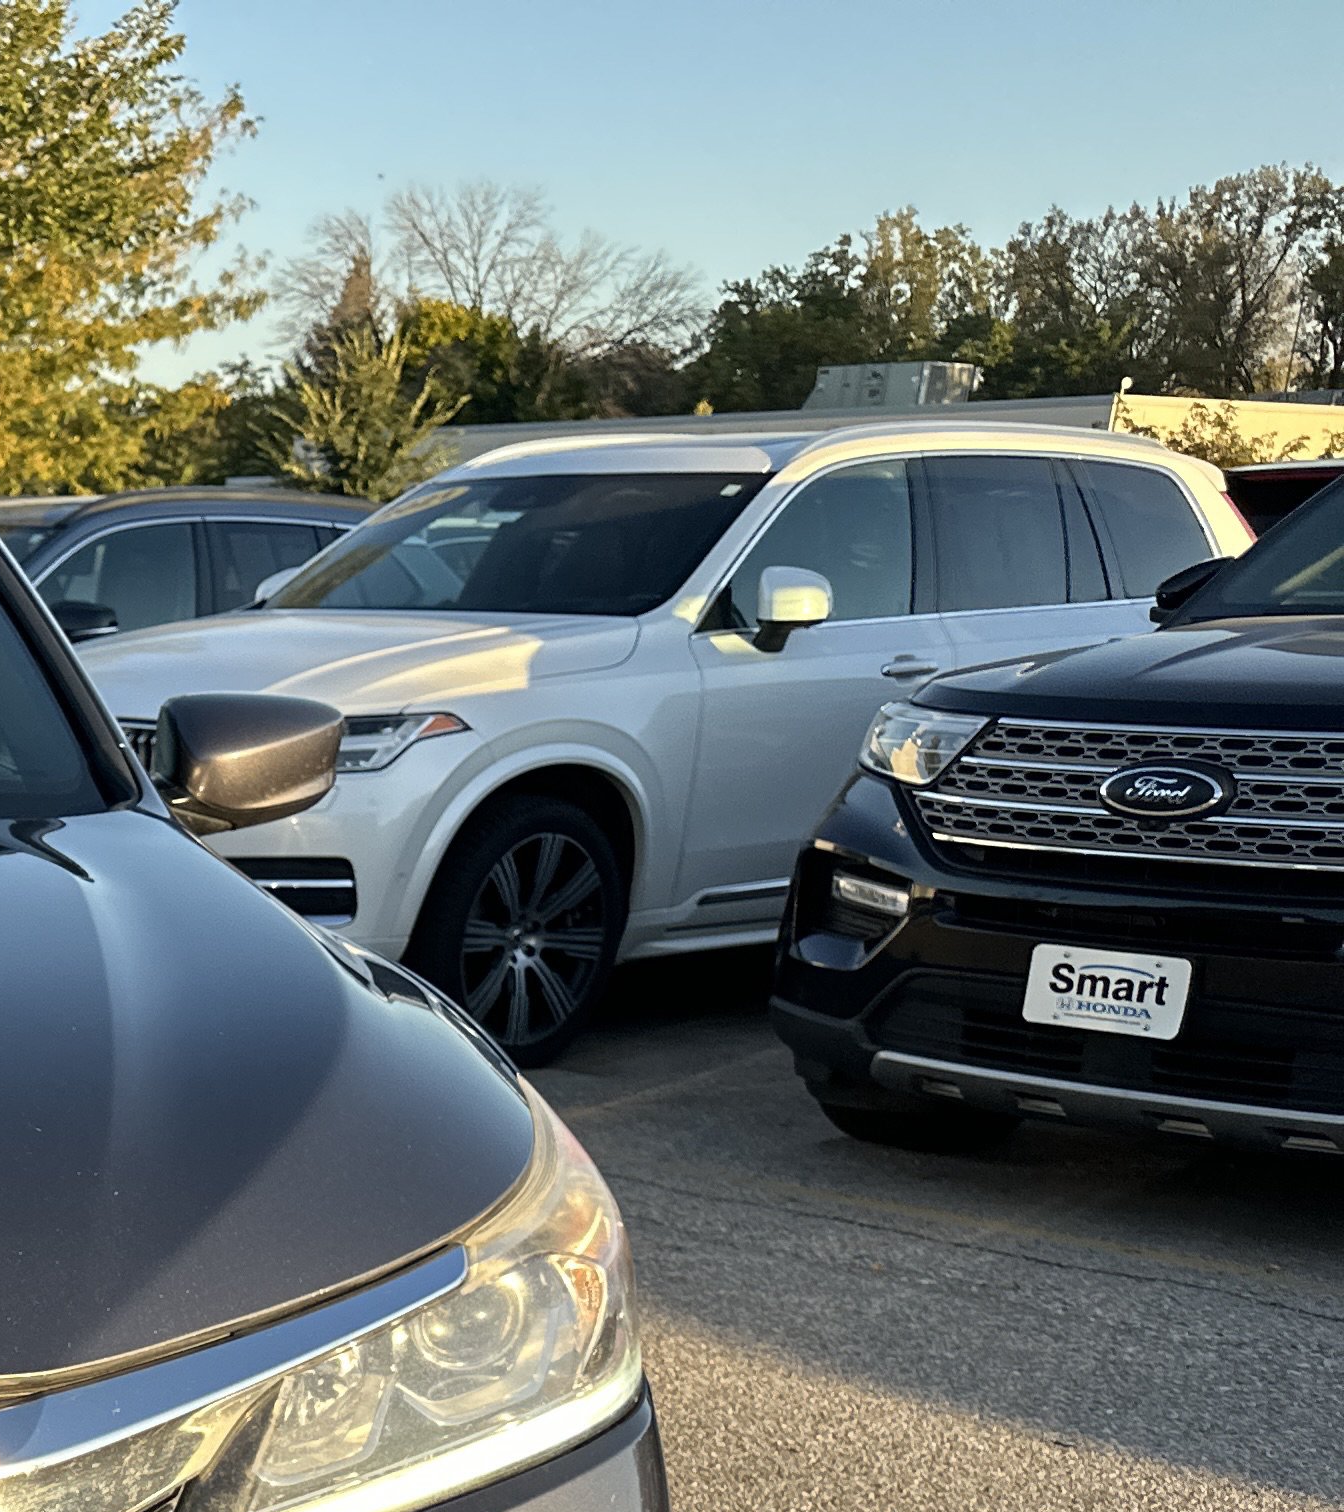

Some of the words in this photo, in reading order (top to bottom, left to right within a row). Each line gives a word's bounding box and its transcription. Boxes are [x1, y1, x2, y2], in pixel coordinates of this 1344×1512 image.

[1125, 775, 1192, 800] Ford
[1048, 963, 1169, 1006] Smart
[1076, 1000, 1152, 1020] HONDA
